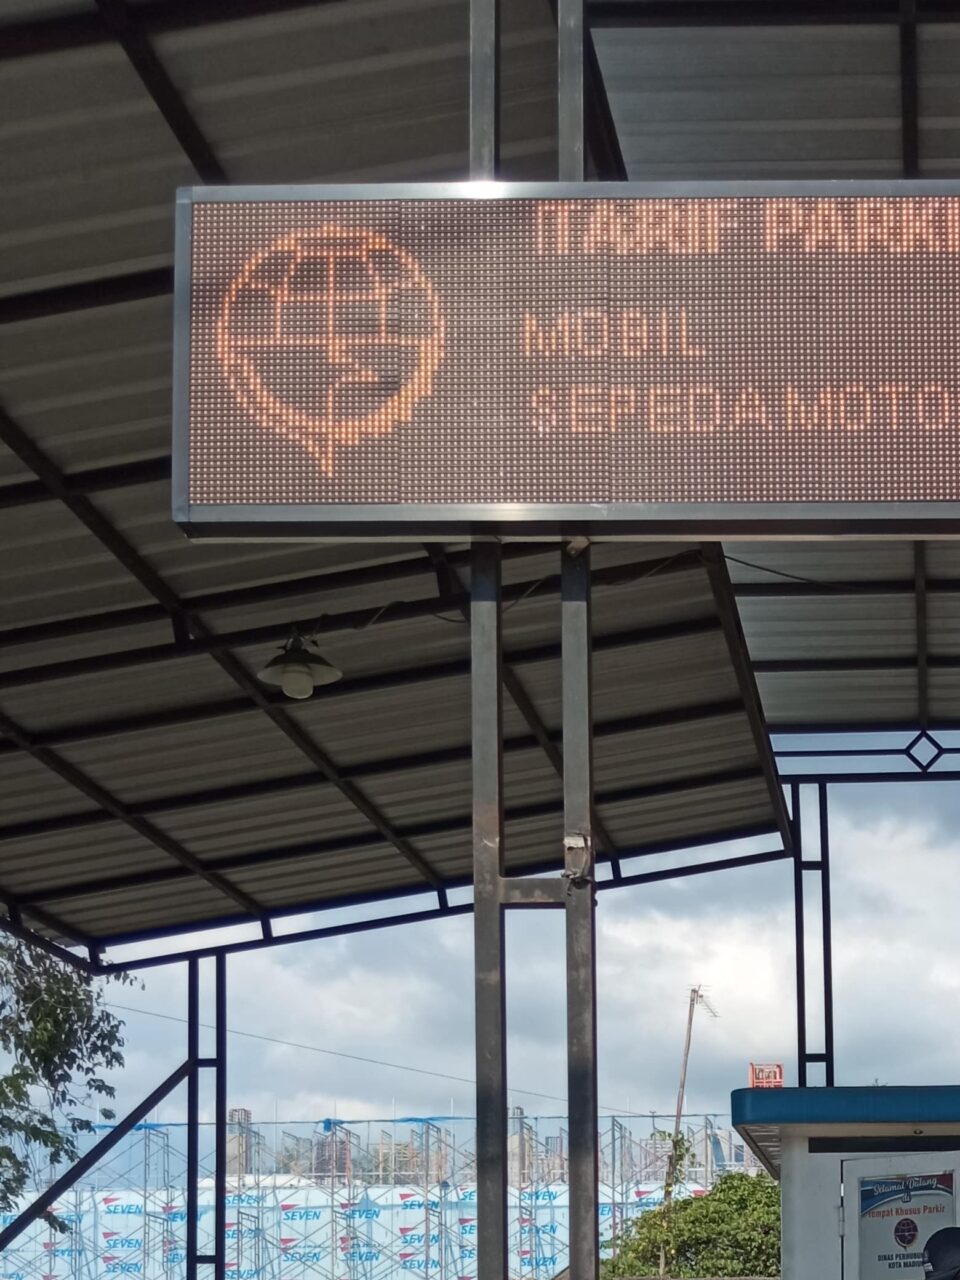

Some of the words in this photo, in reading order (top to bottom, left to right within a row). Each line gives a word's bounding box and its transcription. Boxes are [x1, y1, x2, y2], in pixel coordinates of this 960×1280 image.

[523, 309, 706, 358] MOBIL
[530, 388, 768, 433] SEPEDA
[873, 1182, 905, 1196] Selamat
[906, 1177, 937, 1190] Datang
[902, 1193, 910, 1202] di
[105, 1204, 143, 1214] SEVEN
[895, 1206, 922, 1217] Khusus
[923, 1204, 946, 1214] Parkir
[283, 1210, 321, 1221] SEVEN
[105, 1238, 142, 1249] SEVEN
[283, 1252, 320, 1262] SEVEN
[105, 1263, 142, 1273] SEVEN
[888, 1261, 902, 1269] KOTA
